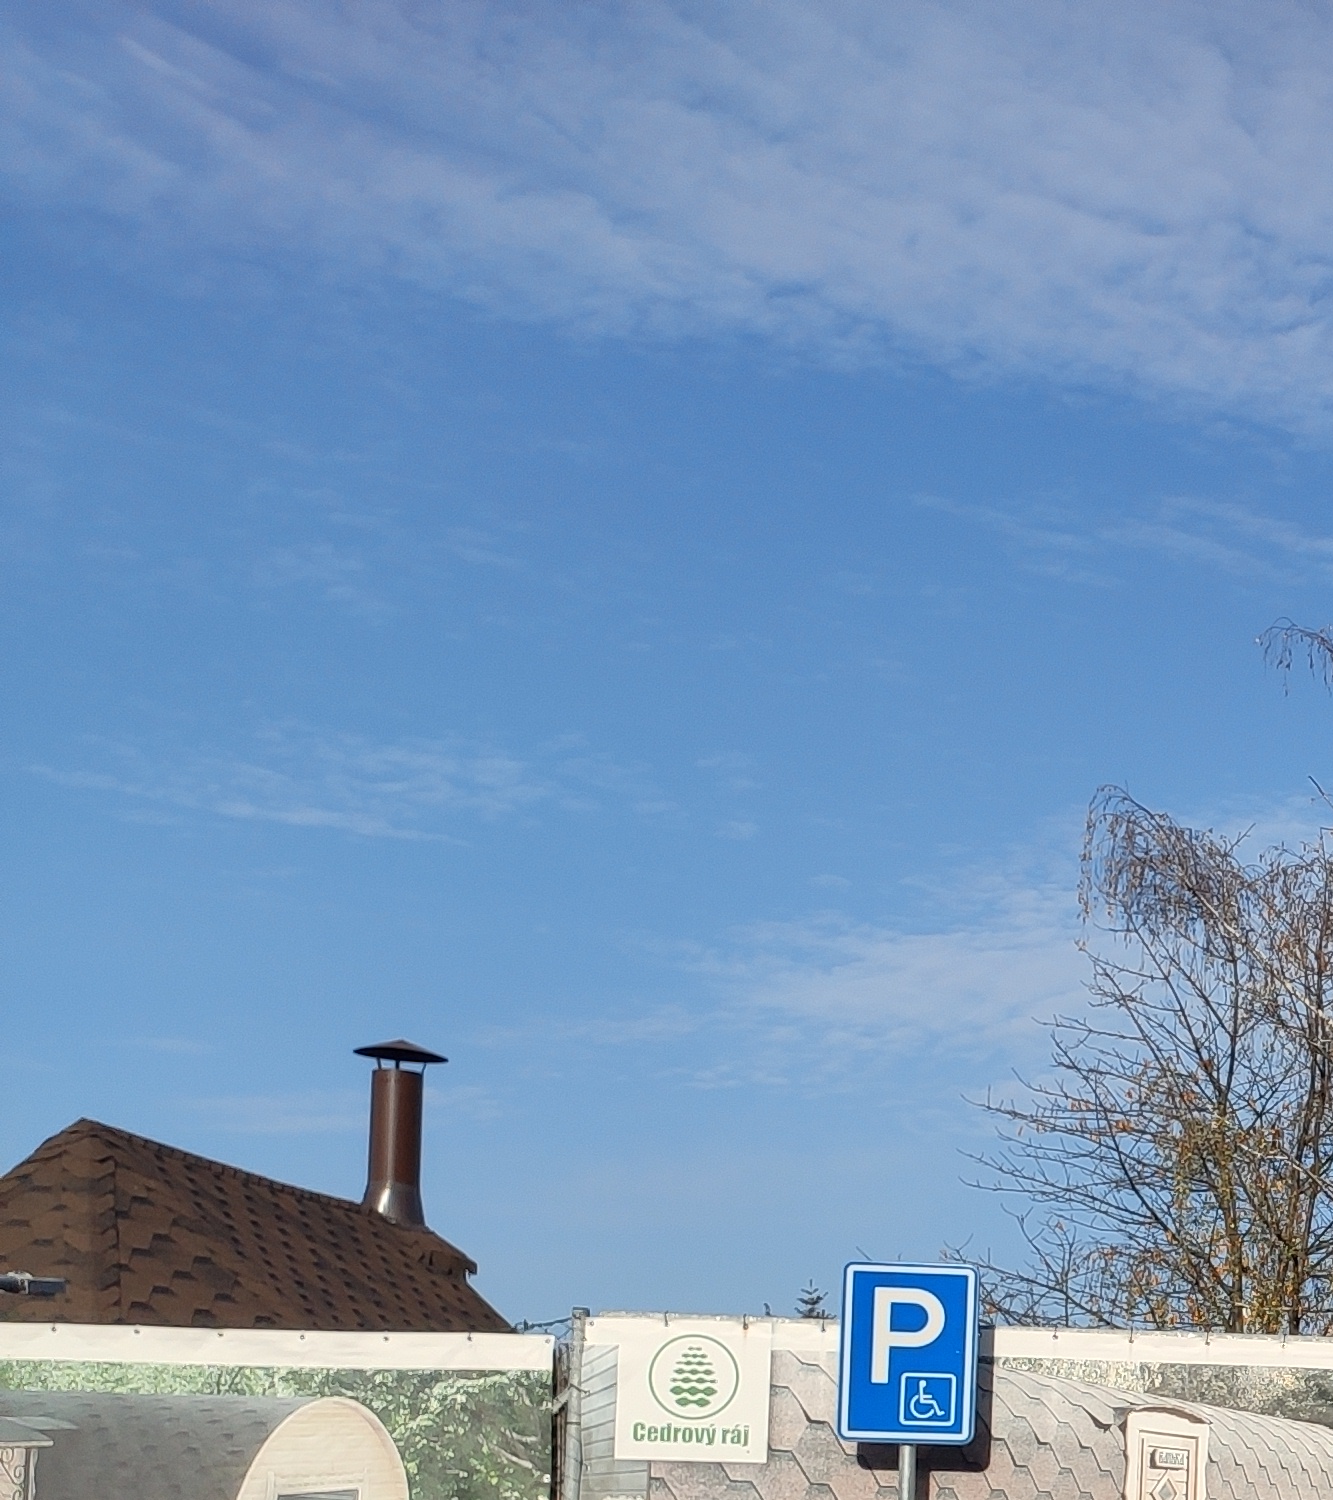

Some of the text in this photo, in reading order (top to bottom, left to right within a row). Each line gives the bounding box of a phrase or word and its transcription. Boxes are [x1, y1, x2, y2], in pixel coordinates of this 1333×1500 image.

[871, 1286, 946, 1384] P
[632, 1421, 750, 1447] Cedrový ráj
